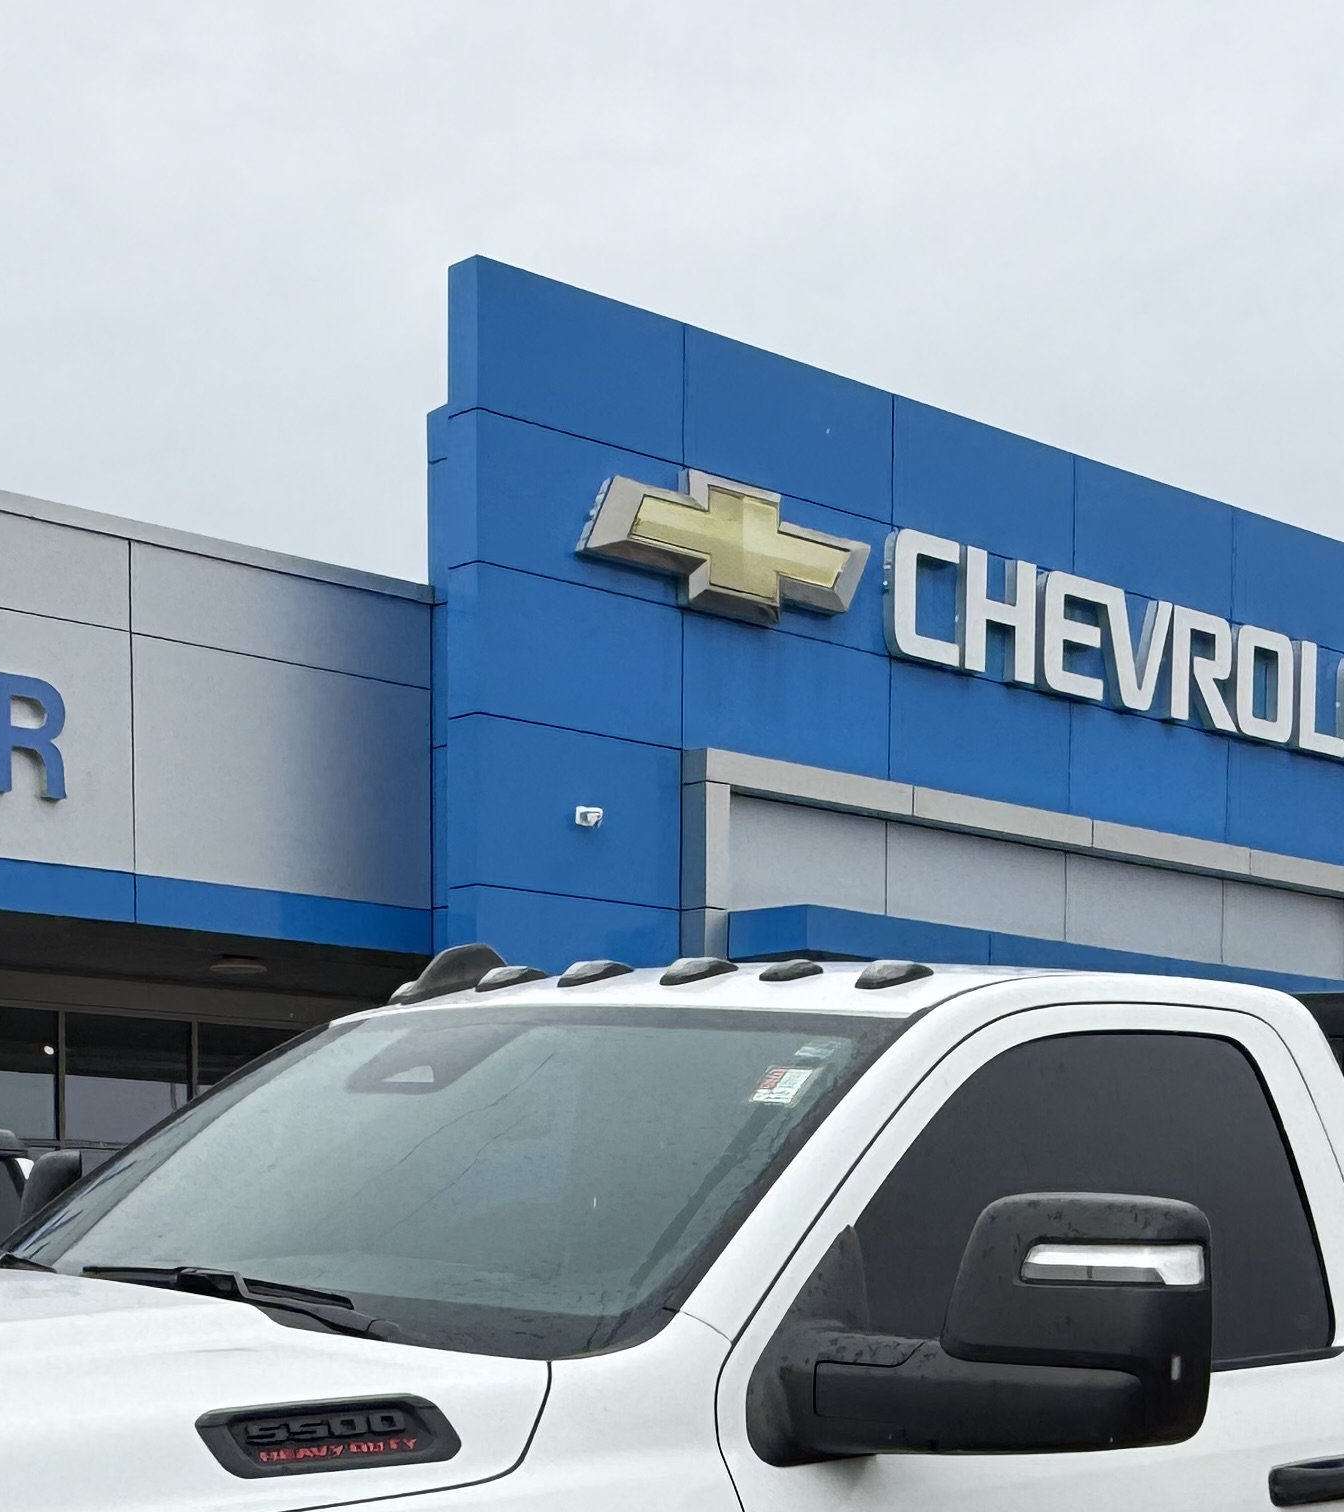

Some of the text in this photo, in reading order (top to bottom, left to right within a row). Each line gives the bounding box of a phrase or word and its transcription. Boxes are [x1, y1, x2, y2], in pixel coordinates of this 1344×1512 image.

[246, 1411, 405, 1443] 5500
[259, 1438, 417, 1462] HEAVY DUTY
